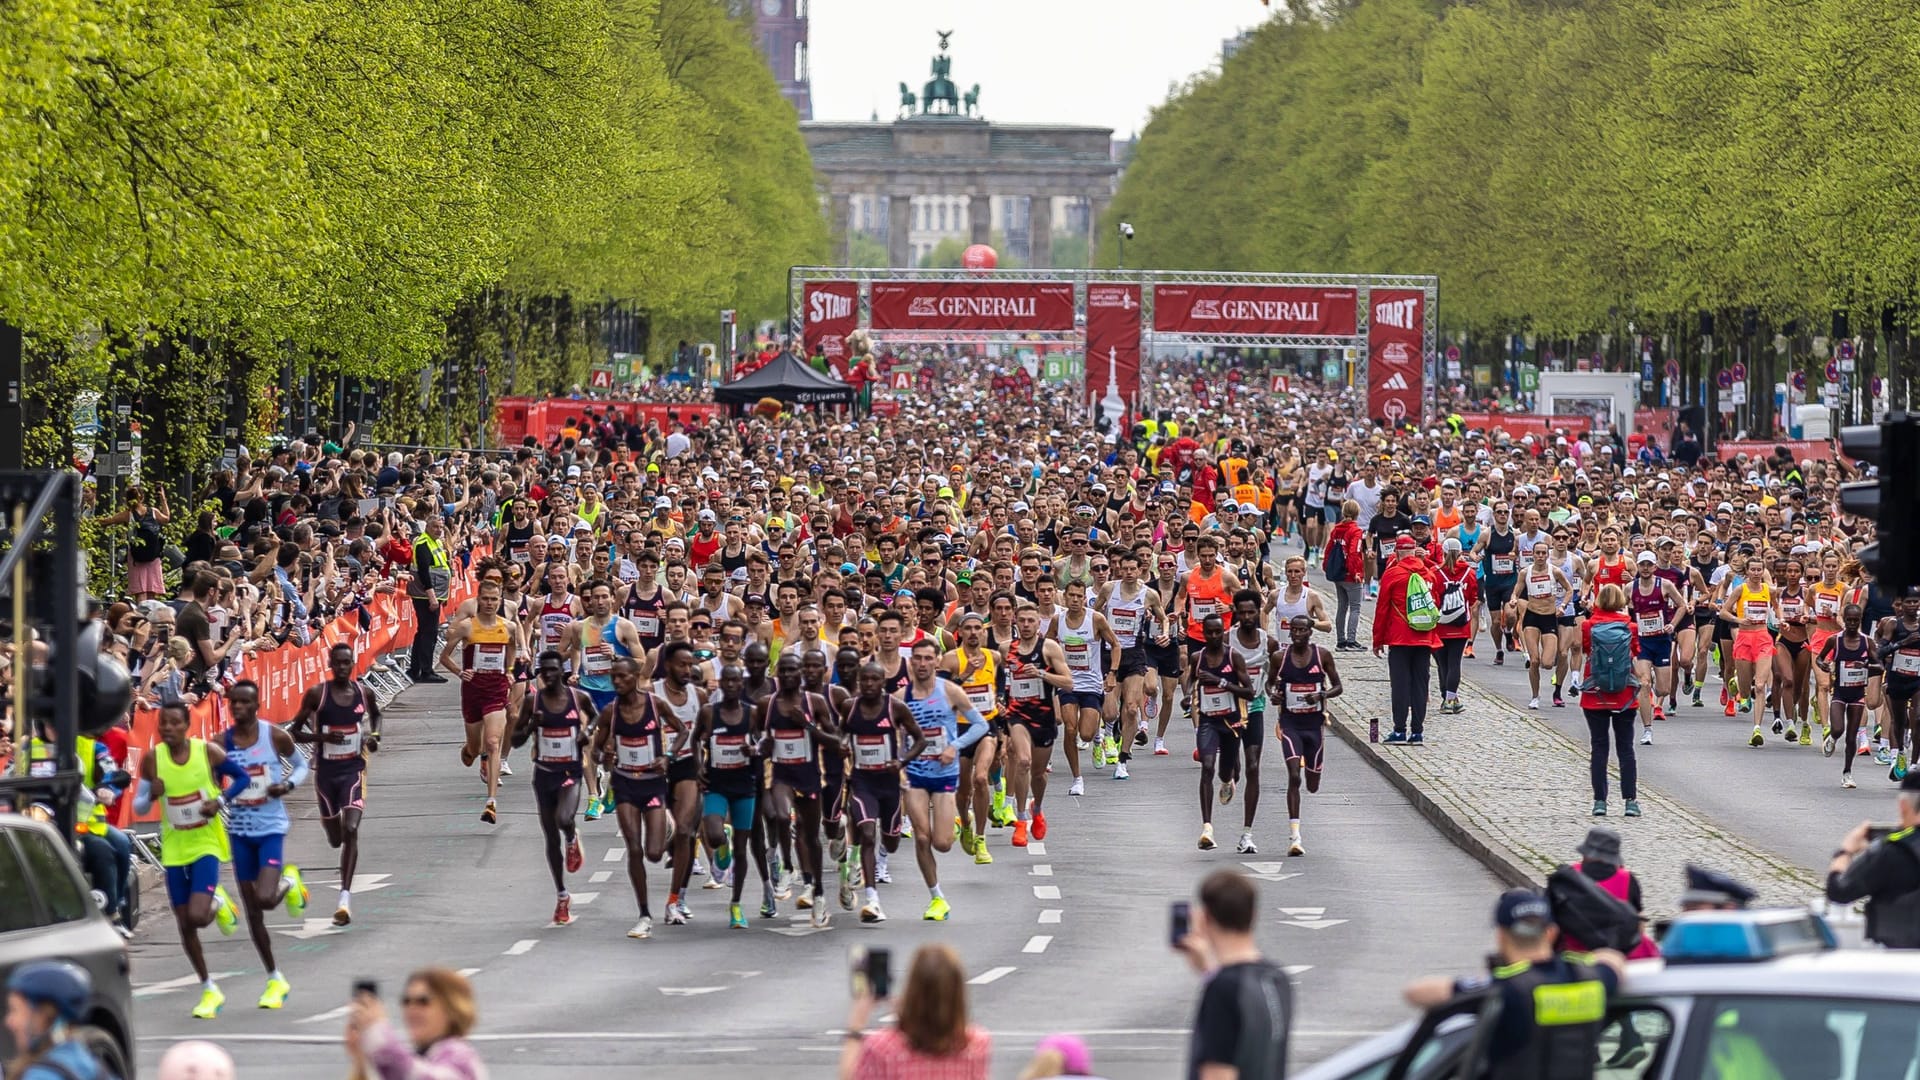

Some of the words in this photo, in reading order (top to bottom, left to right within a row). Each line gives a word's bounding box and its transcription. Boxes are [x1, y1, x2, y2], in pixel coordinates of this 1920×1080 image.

[810, 291, 852, 323] START
[939, 297, 1036, 317] GENERALI
[1222, 300, 1319, 321] GENERALI
[1376, 298, 1417, 329] START
[618, 363, 628, 376] B
[1049, 362, 1060, 376] B
[595, 372, 607, 387] A
[896, 373, 908, 388] A
[1274, 377, 1286, 392] A
[1525, 374, 1535, 387] B
